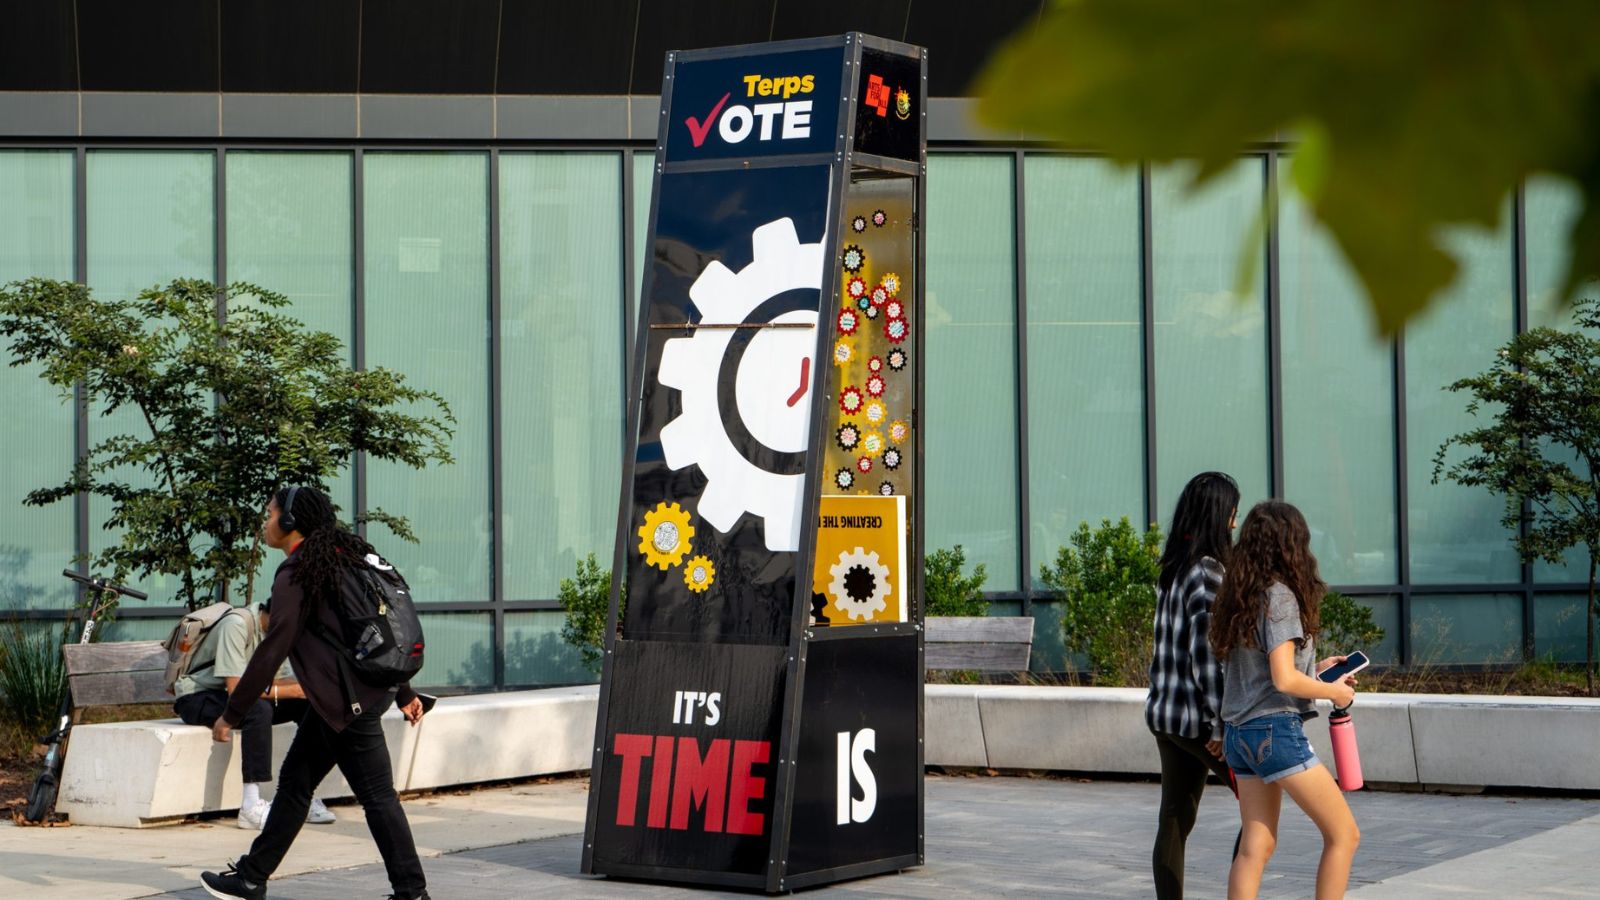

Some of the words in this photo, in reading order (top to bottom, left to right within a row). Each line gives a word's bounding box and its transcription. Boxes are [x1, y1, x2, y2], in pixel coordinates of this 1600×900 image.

[743, 75, 815, 98] Terps
[823, 516, 838, 528] THE
[841, 516, 882, 528] CREATING
[672, 691, 721, 726] IT'S
[613, 733, 771, 835] TIME
[836, 727, 877, 825] IS
